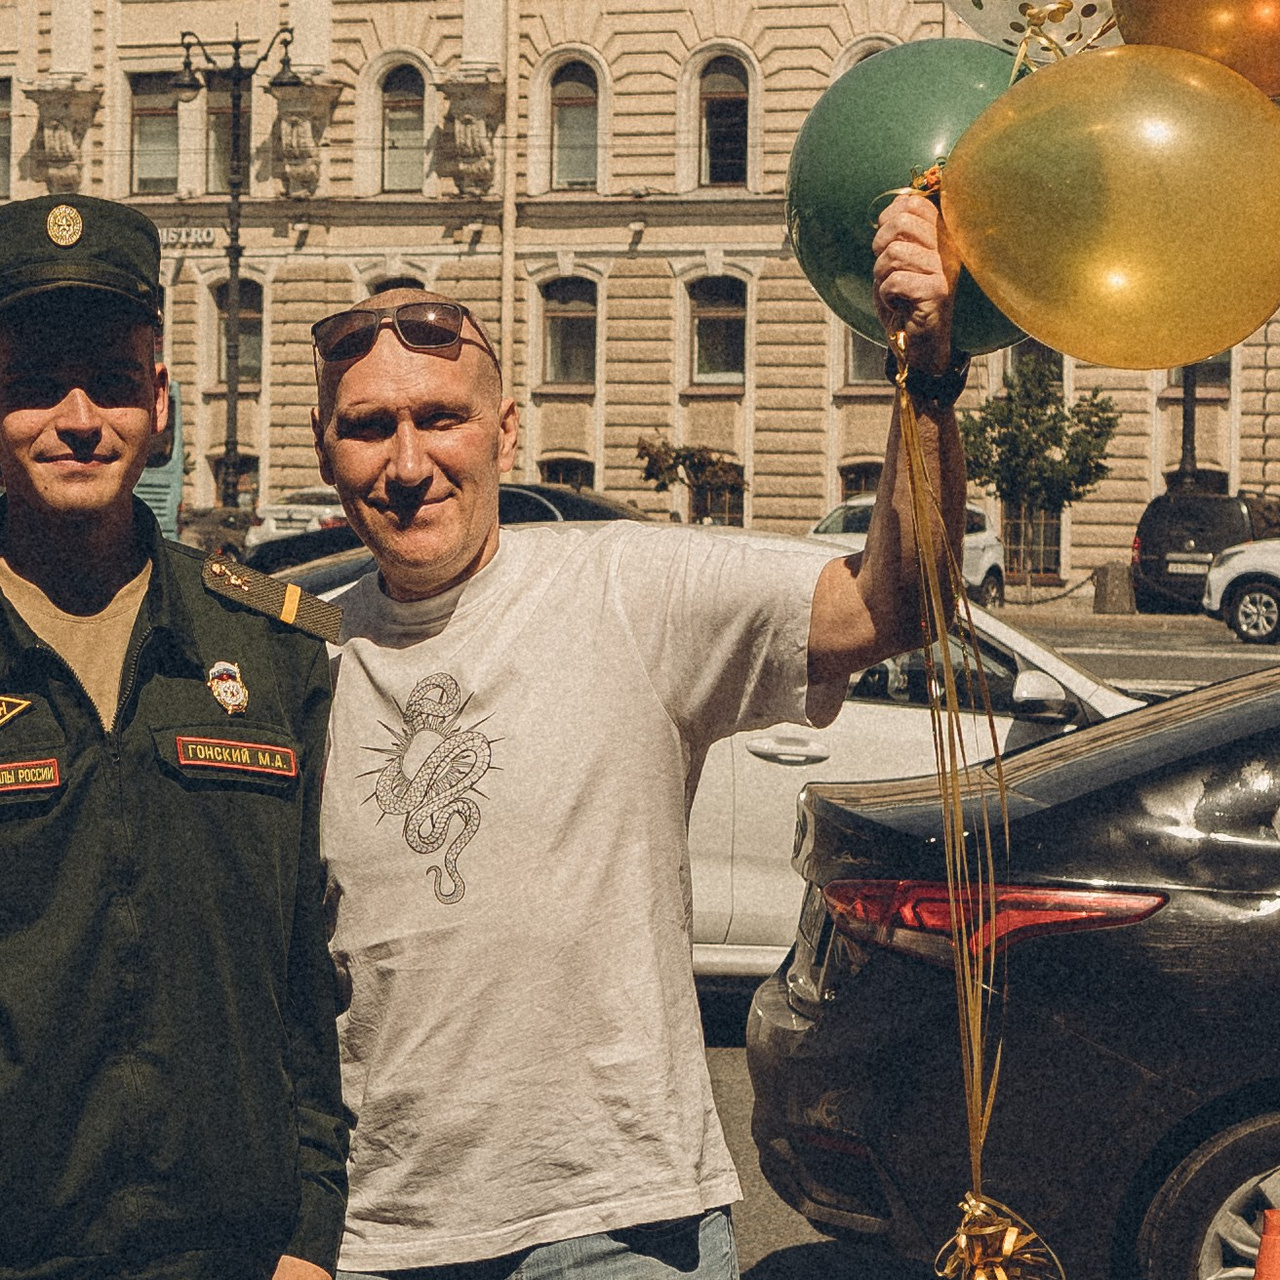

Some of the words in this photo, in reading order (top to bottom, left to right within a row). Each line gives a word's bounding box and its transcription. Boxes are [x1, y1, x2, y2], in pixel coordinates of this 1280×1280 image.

[159, 227, 215, 244] ISTRO
[187, 744, 251, 764] ГОНСКИЙ
[257, 751, 289, 769] М.А.
[18, 766, 55, 783] РОССИИ
